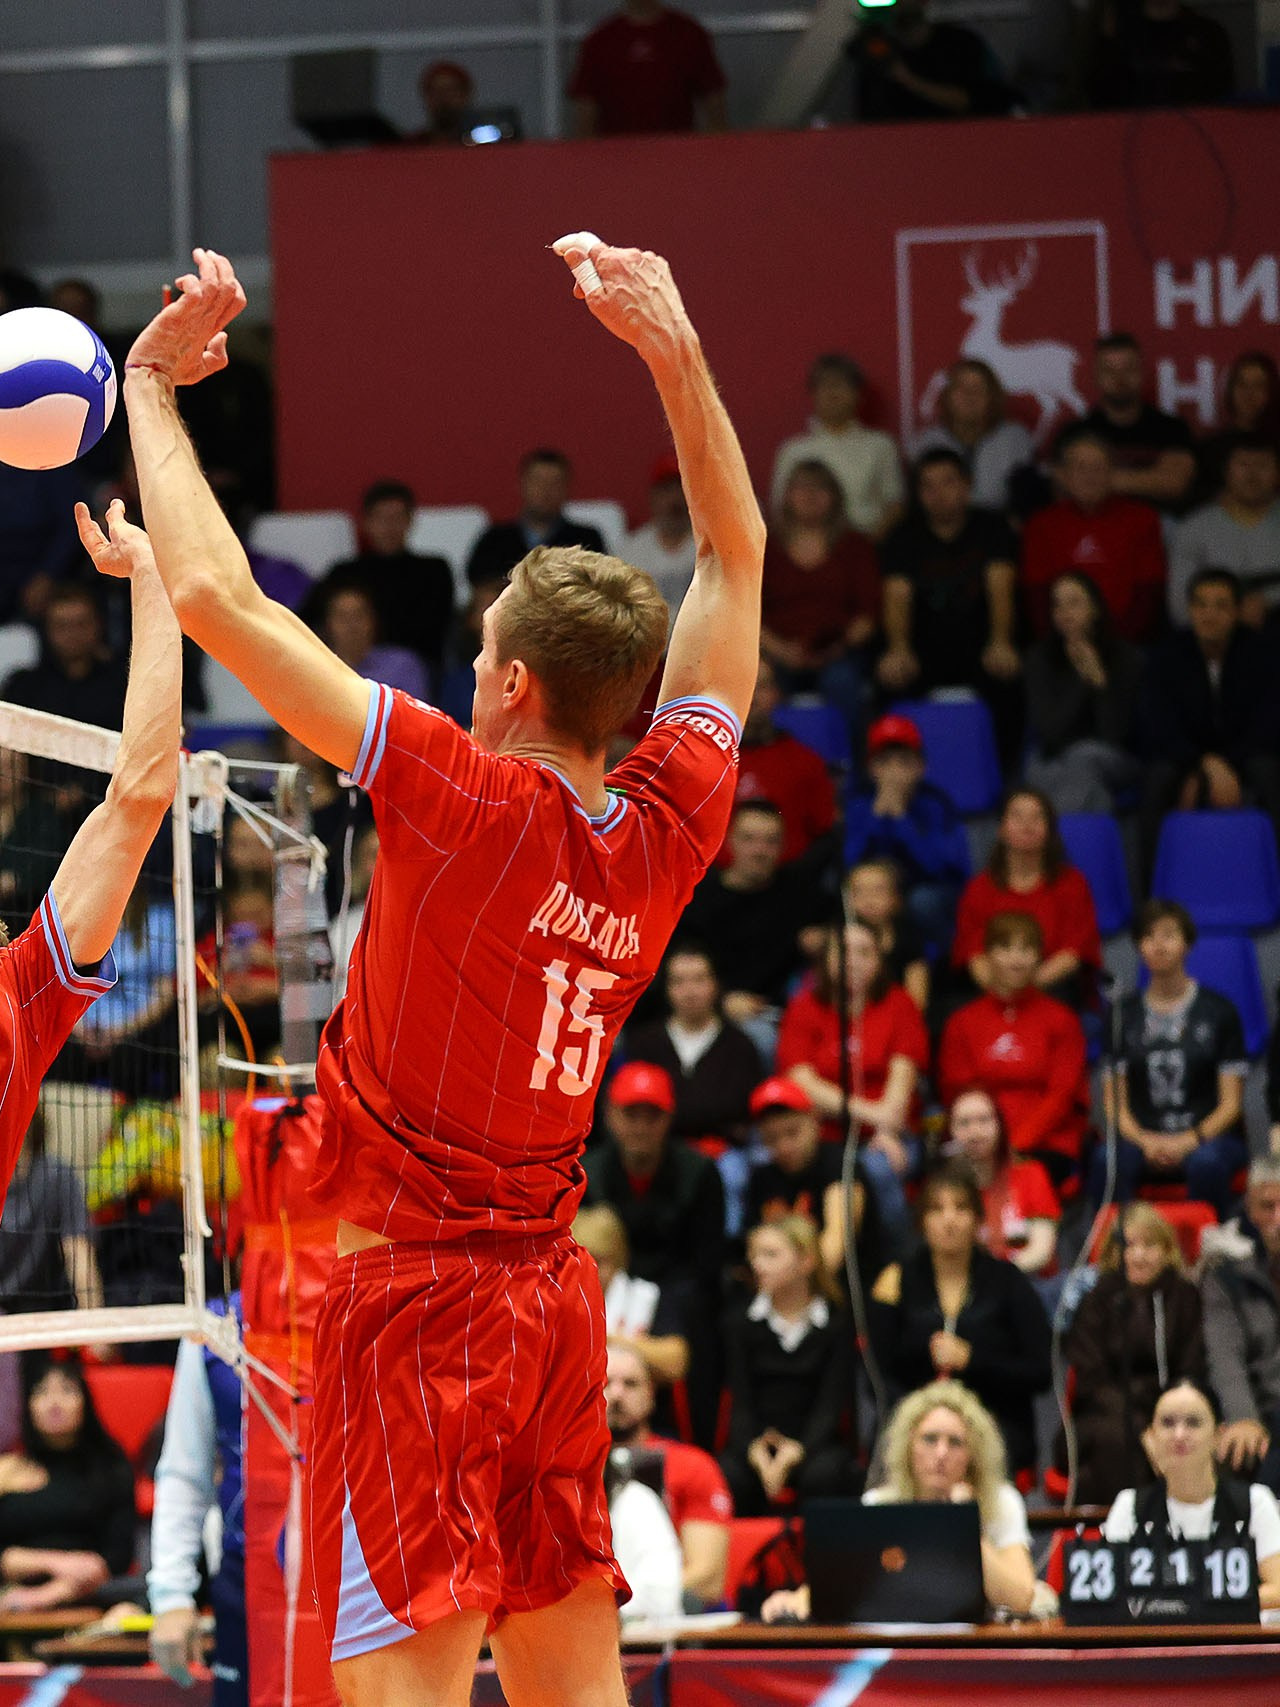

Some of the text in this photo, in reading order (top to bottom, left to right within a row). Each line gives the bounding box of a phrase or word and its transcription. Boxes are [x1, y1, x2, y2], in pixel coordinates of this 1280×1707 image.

[1157, 356, 1220, 427] Н
[528, 958, 620, 1097] 15
[1069, 1547, 1251, 1600] 23 2 1 19
